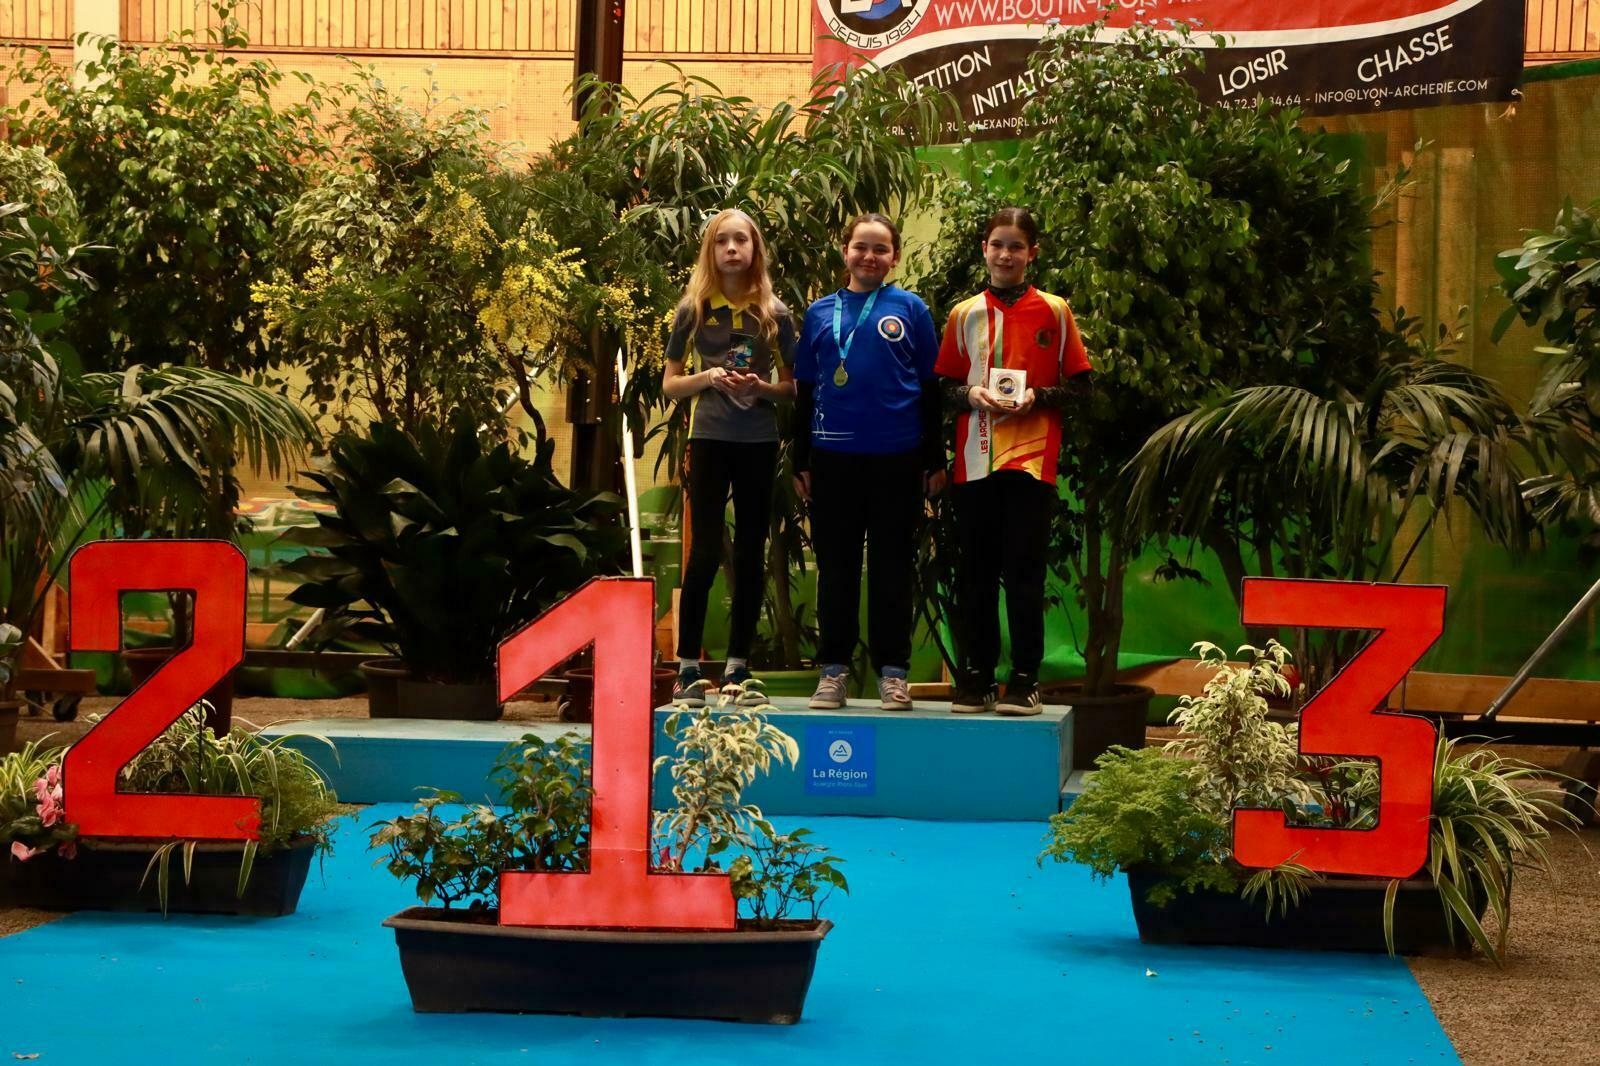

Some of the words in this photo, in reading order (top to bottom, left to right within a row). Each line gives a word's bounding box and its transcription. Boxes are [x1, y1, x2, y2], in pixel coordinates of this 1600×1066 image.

[828, 17, 883, 49] DEPUIS
[886, 9, 922, 45] 1984
[1357, 25, 1454, 82] CHASSE
[971, 57, 1068, 117] INITIATIO
[1218, 49, 1289, 96] LOISIR
[1314, 79, 1489, 104] INFO@LYON-ARCHERIE.COM
[980, 439, 989, 454] LES
[64, 539, 261, 841] 2
[497, 576, 737, 929] 1
[1232, 576, 1449, 880] 3
[812, 768, 826, 778] La
[828, 768, 868, 781] Région
